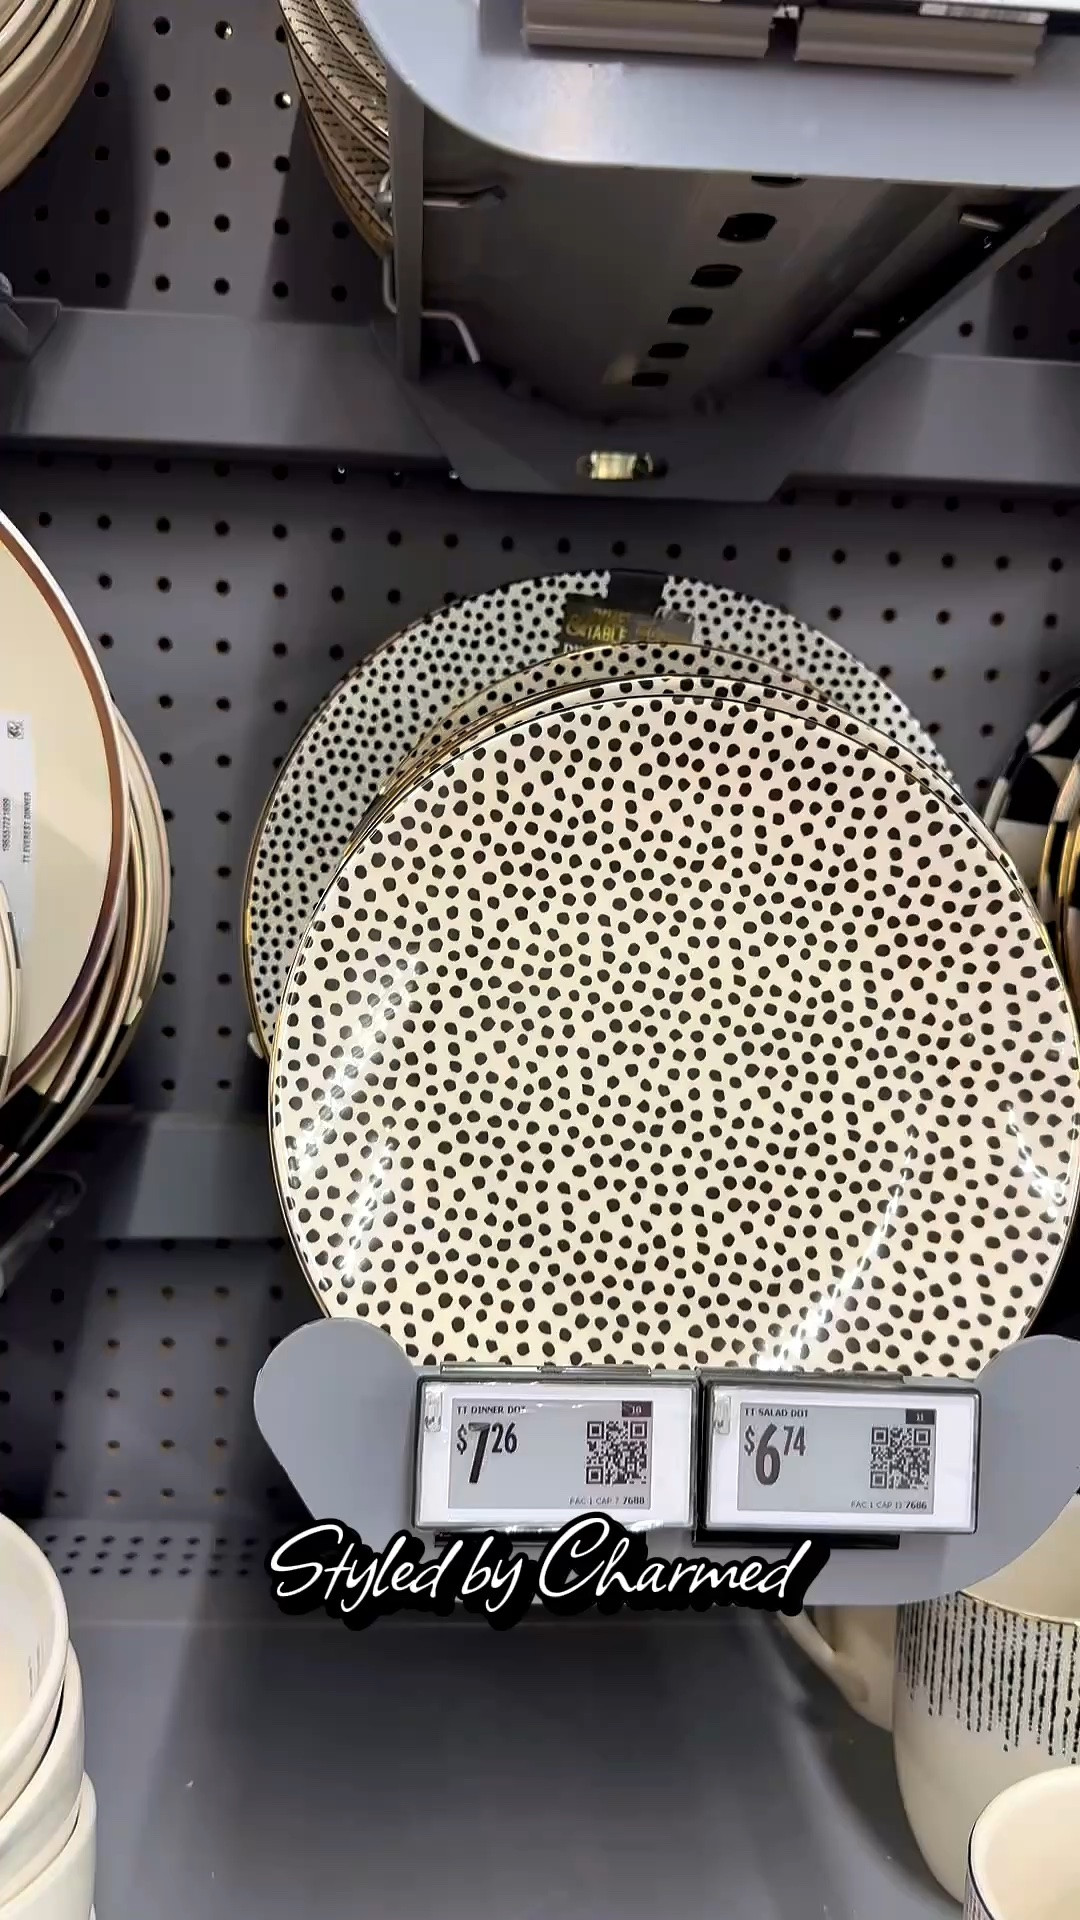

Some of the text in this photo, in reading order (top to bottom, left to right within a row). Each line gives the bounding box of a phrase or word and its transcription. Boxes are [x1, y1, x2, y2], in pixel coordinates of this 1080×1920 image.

[23, 792, 31, 820] DINNER
[22, 821, 31, 853] EVEREST
[457, 1406, 467, 1415] TT
[471, 1405, 504, 1414] DINNER
[745, 1408, 808, 1417] TT SALAD DOT
[595, 1496, 613, 1505] CAP
[851, 1501, 867, 1509] FAC
[876, 1501, 892, 1509] CAP
